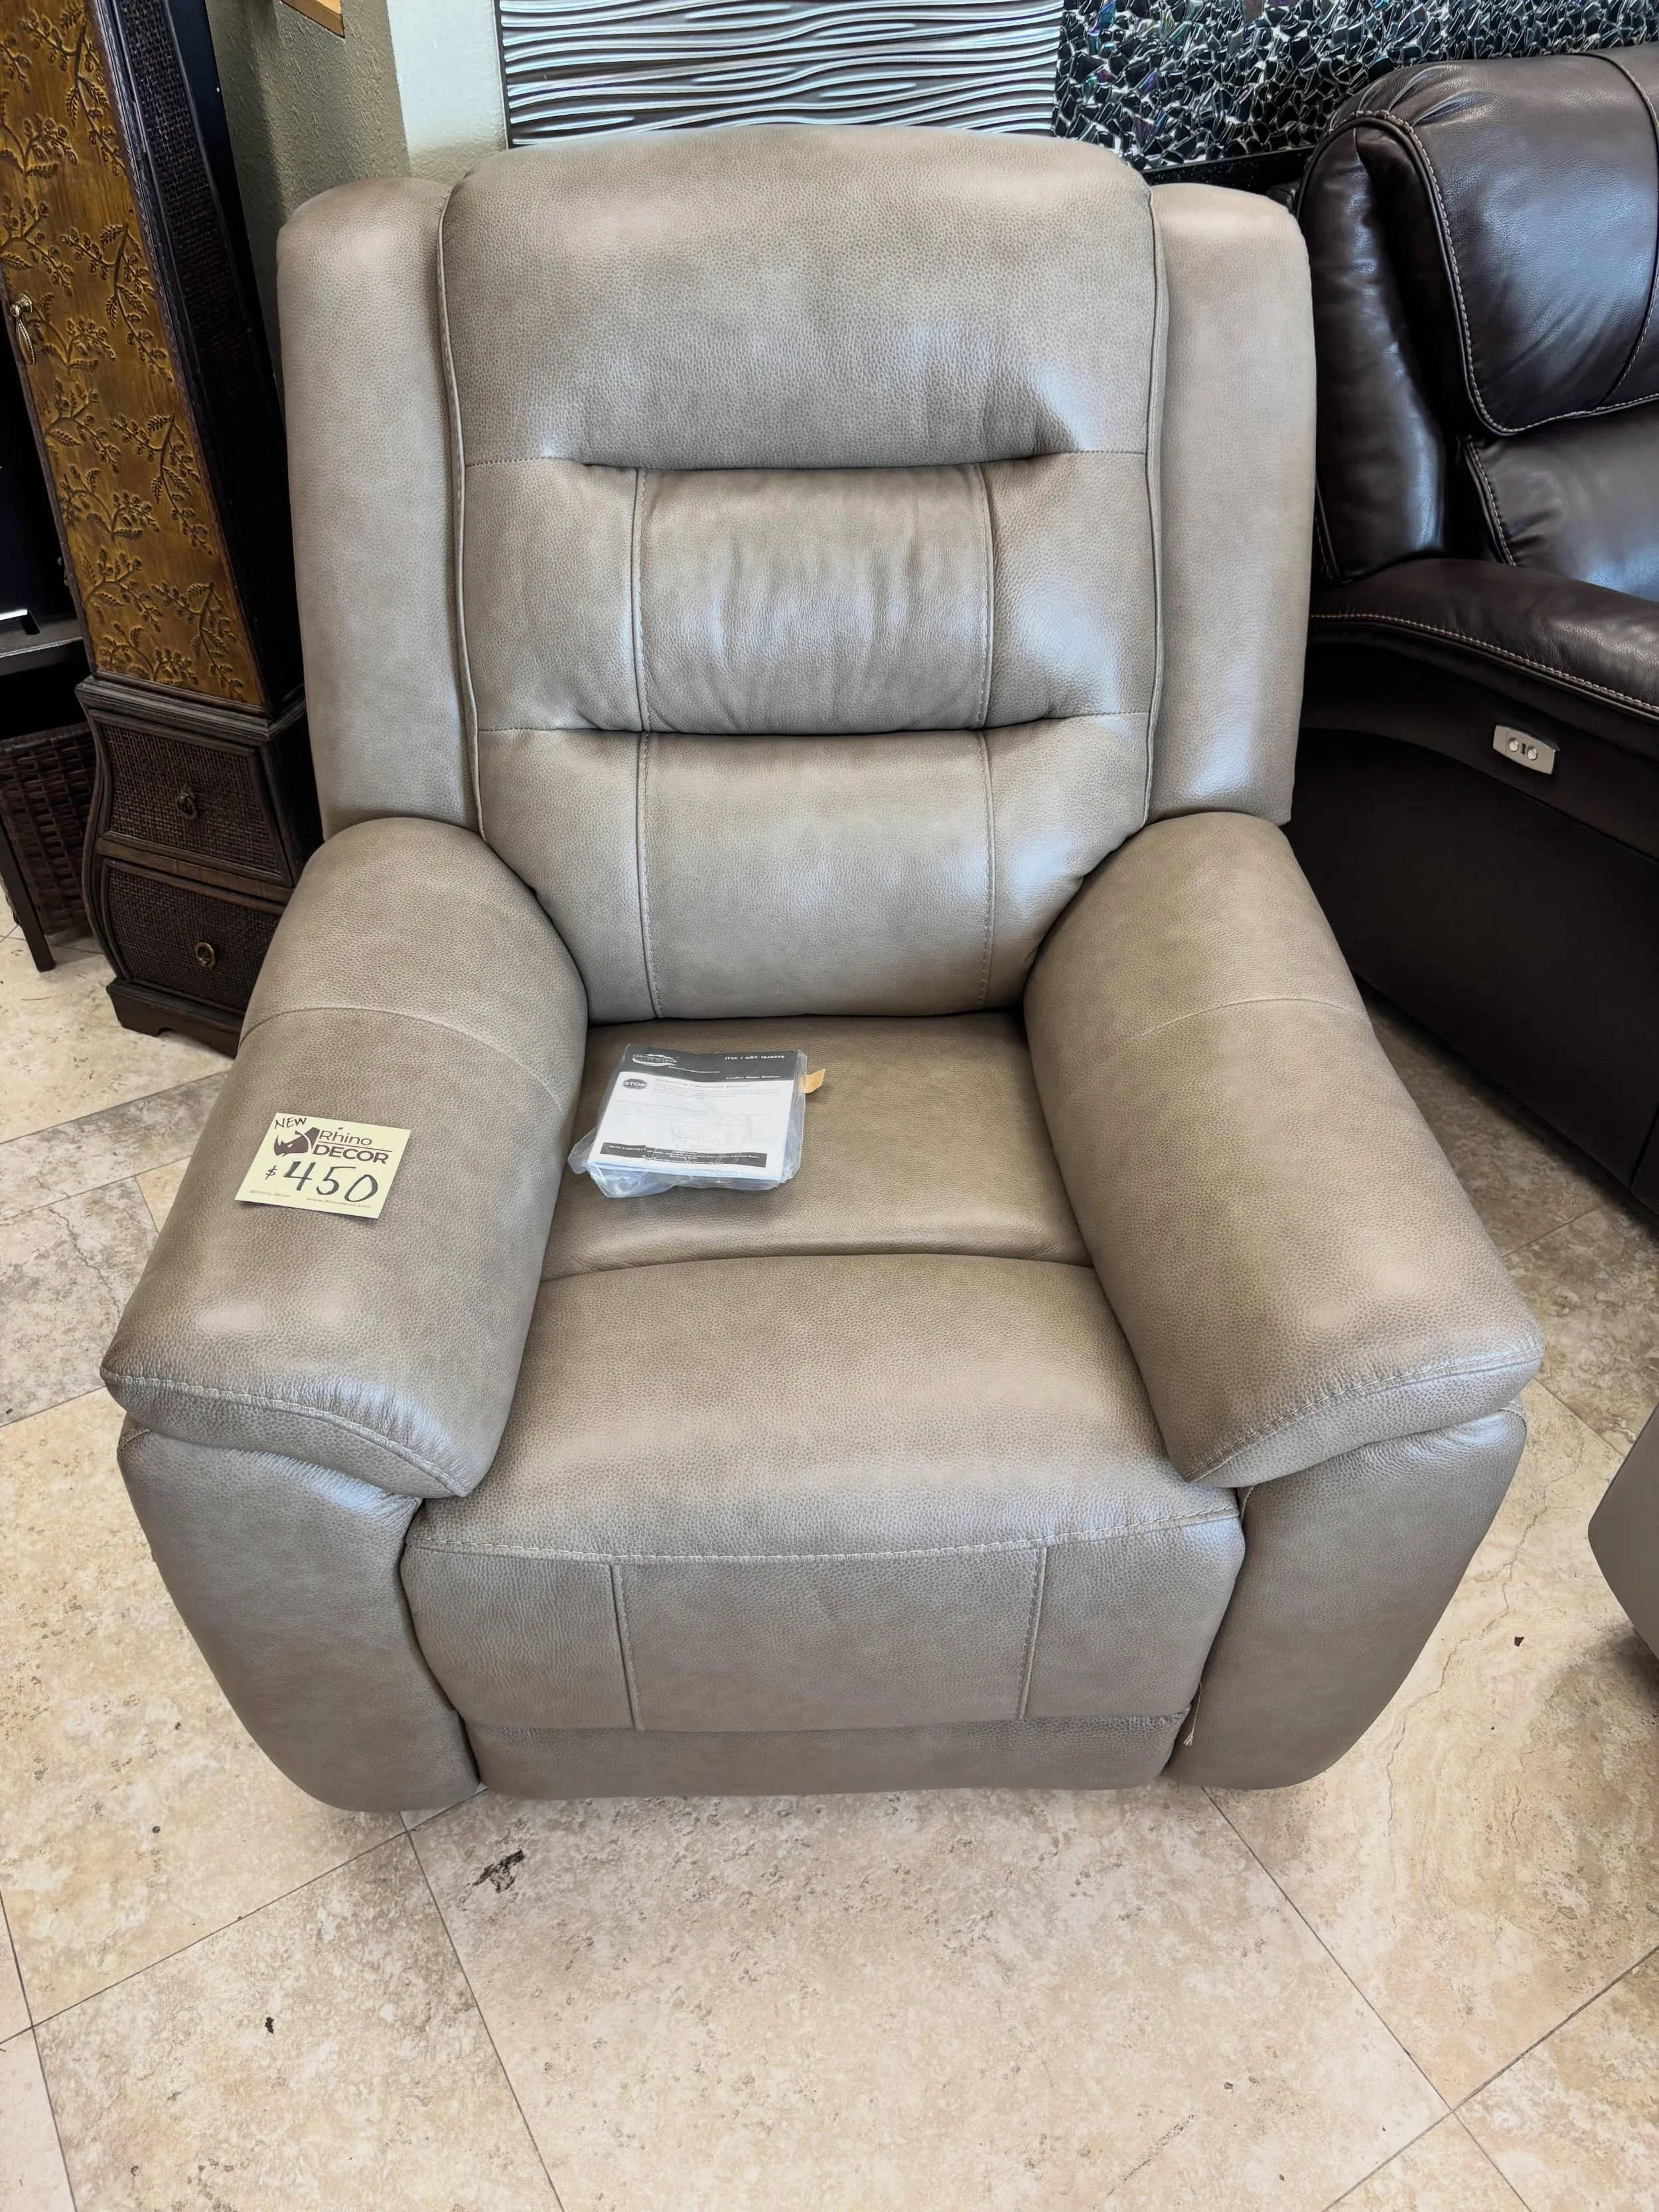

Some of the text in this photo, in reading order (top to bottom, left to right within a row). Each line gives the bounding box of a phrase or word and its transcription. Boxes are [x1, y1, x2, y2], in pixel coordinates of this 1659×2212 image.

[274, 1117, 307, 1129] NEW
[319, 1130, 372, 1145] Rhino
[313, 1143, 389, 1164] DECOR
